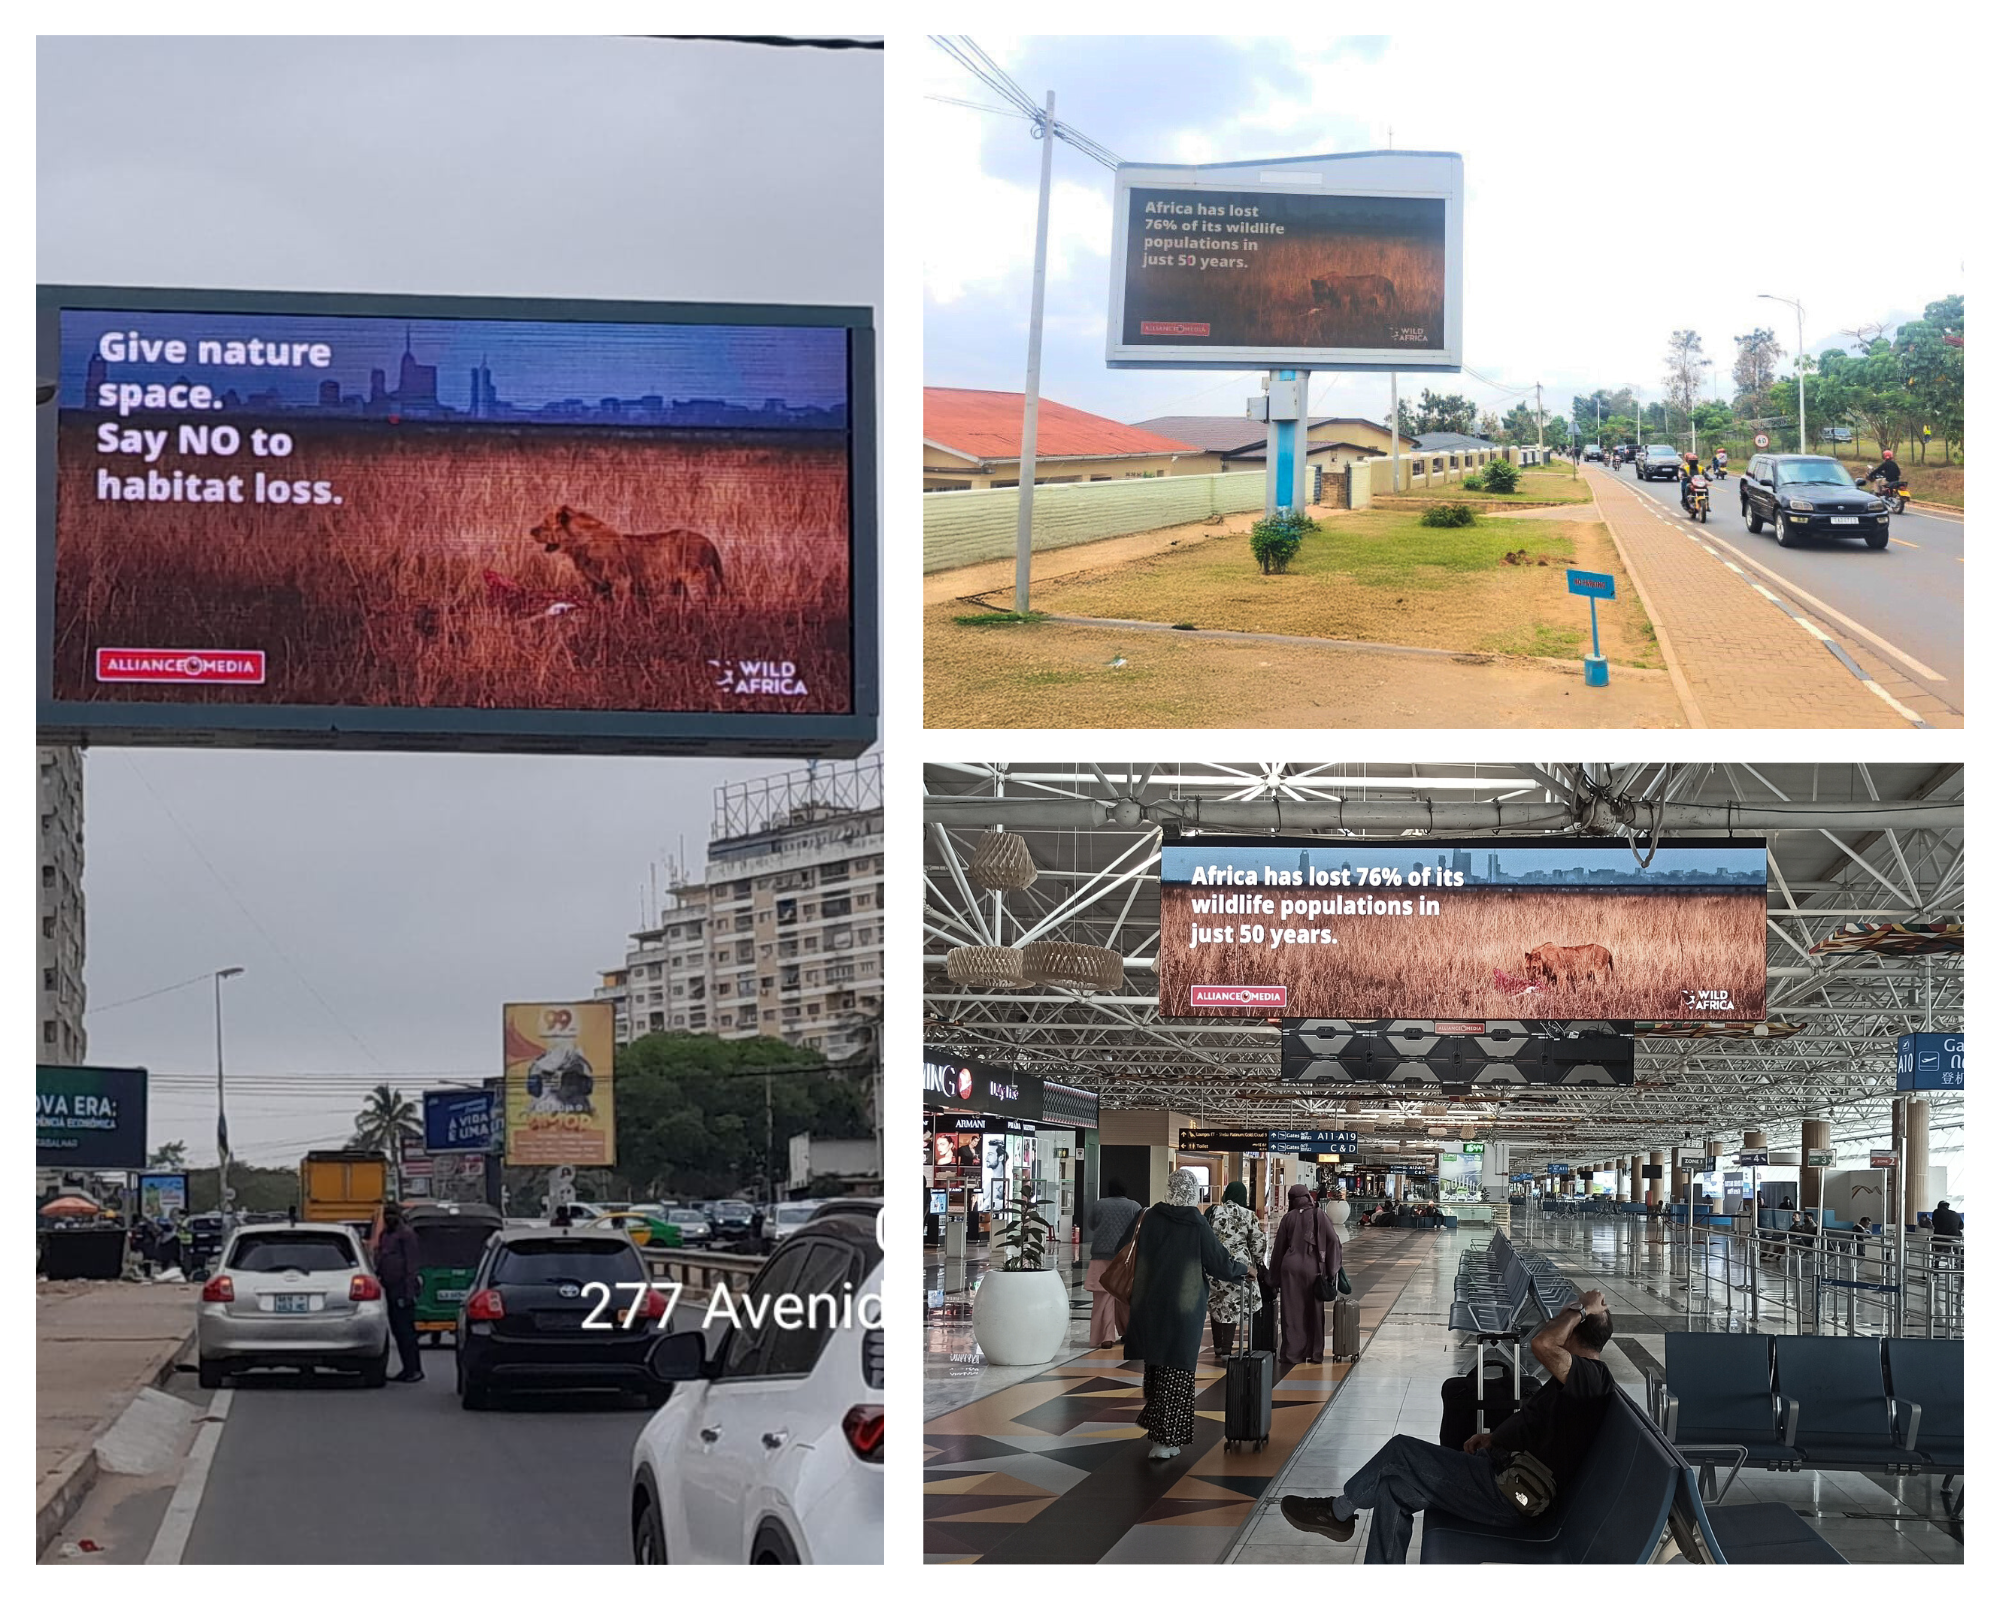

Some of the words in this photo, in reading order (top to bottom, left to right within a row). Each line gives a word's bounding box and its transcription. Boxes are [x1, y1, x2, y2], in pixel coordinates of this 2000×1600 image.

[1145, 201, 1193, 215] Africa
[1197, 203, 1225, 216] has
[1229, 204, 1259, 217] lost
[1145, 219, 1177, 230] 76%
[1182, 220, 1198, 231] of
[1202, 221, 1222, 232] its
[1226, 222, 1285, 234] wildlife
[1144, 236, 1239, 251] populations
[1243, 239, 1258, 251] in
[1142, 253, 1174, 268] just
[1178, 254, 1196, 266] 50
[1200, 257, 1248, 270] years.
[100, 331, 187, 363] Give
[199, 338, 332, 368] nature
[98, 382, 223, 416] space.
[97, 422, 168, 462] Say
[179, 425, 240, 455] NO
[251, 428, 293, 456] to
[97, 468, 244, 501] habitat
[255, 472, 343, 504] loss.
[107, 658, 185, 672] ALLIANCE
[203, 660, 254, 673] MEDIA
[739, 661, 796, 677] WILD
[735, 679, 808, 695] AFRICA
[1191, 865, 1258, 886] Africa
[1264, 865, 1303, 886] has
[1309, 866, 1350, 887] lost
[1356, 867, 1402, 887] 76%
[1408, 866, 1432, 887] of
[1436, 867, 1465, 887] its
[1191, 894, 1275, 915] wildlife
[1281, 895, 1413, 921] populations
[1419, 896, 1440, 916] in
[1189, 923, 1234, 948] just
[1240, 924, 1264, 944] 50
[1270, 927, 1338, 949] years.
[1197, 992, 1240, 1001] ALLIANCE
[1251, 993, 1280, 1001] MEDIA
[1698, 991, 1728, 1000] WILD
[1696, 1001, 1735, 1010] AFRICA
[1897, 1053, 1914, 1074] A10
[74, 1096, 117, 1117] ERA:
[956, 1120, 986, 1129] ARMANI
[1318, 1132, 1357, 1141] A11-A19
[1330, 1144, 1337, 1153] C
[1339, 1144, 1346, 1153] &
[1349, 1144, 1356, 1153] D
[1753, 1154, 1760, 1163] 4
[1821, 1156, 1827, 1164] 3
[1888, 1157, 1895, 1166] 2
